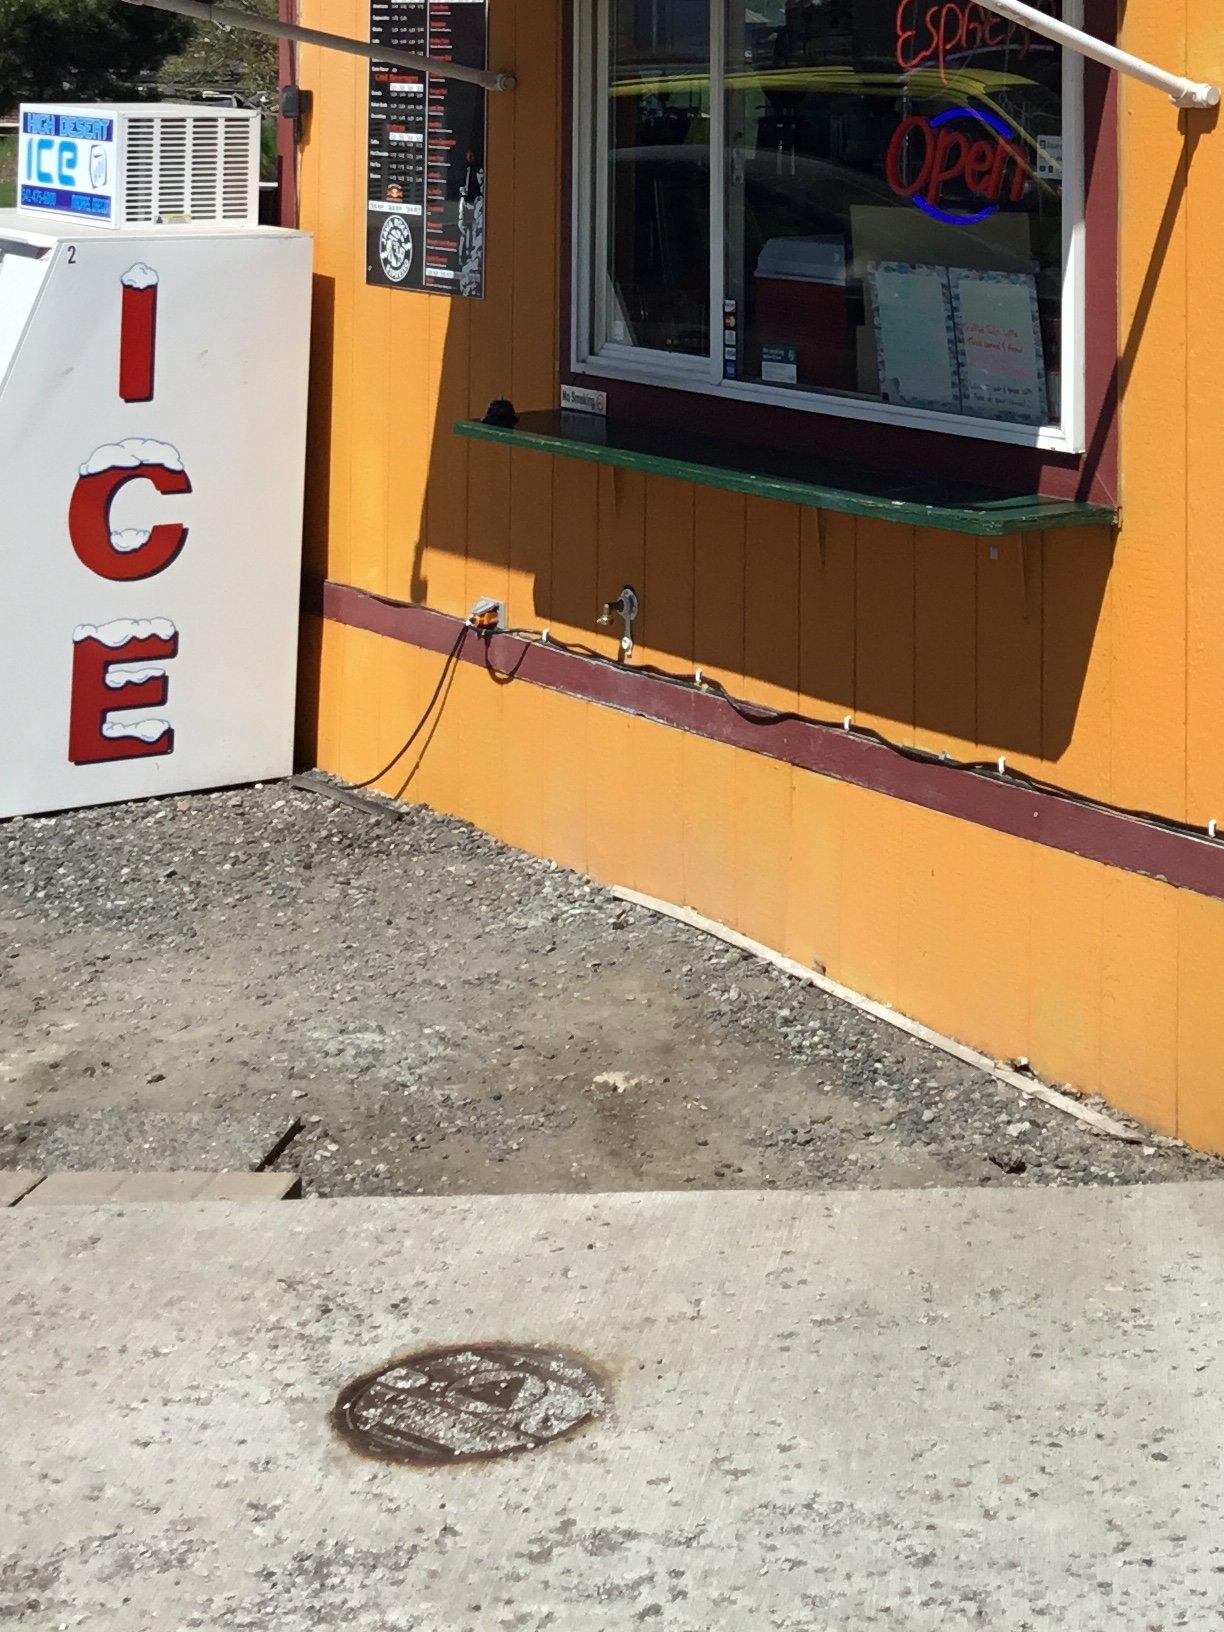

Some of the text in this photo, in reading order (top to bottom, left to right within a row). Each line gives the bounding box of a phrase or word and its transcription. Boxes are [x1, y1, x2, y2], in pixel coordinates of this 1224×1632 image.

[27, 112, 110, 141] HIGH DESERT
[885, 116, 1027, 205] Open
[67, 245, 77, 265] 2
[571, 391, 596, 410] Smoking
[69, 263, 193, 766] ICE
